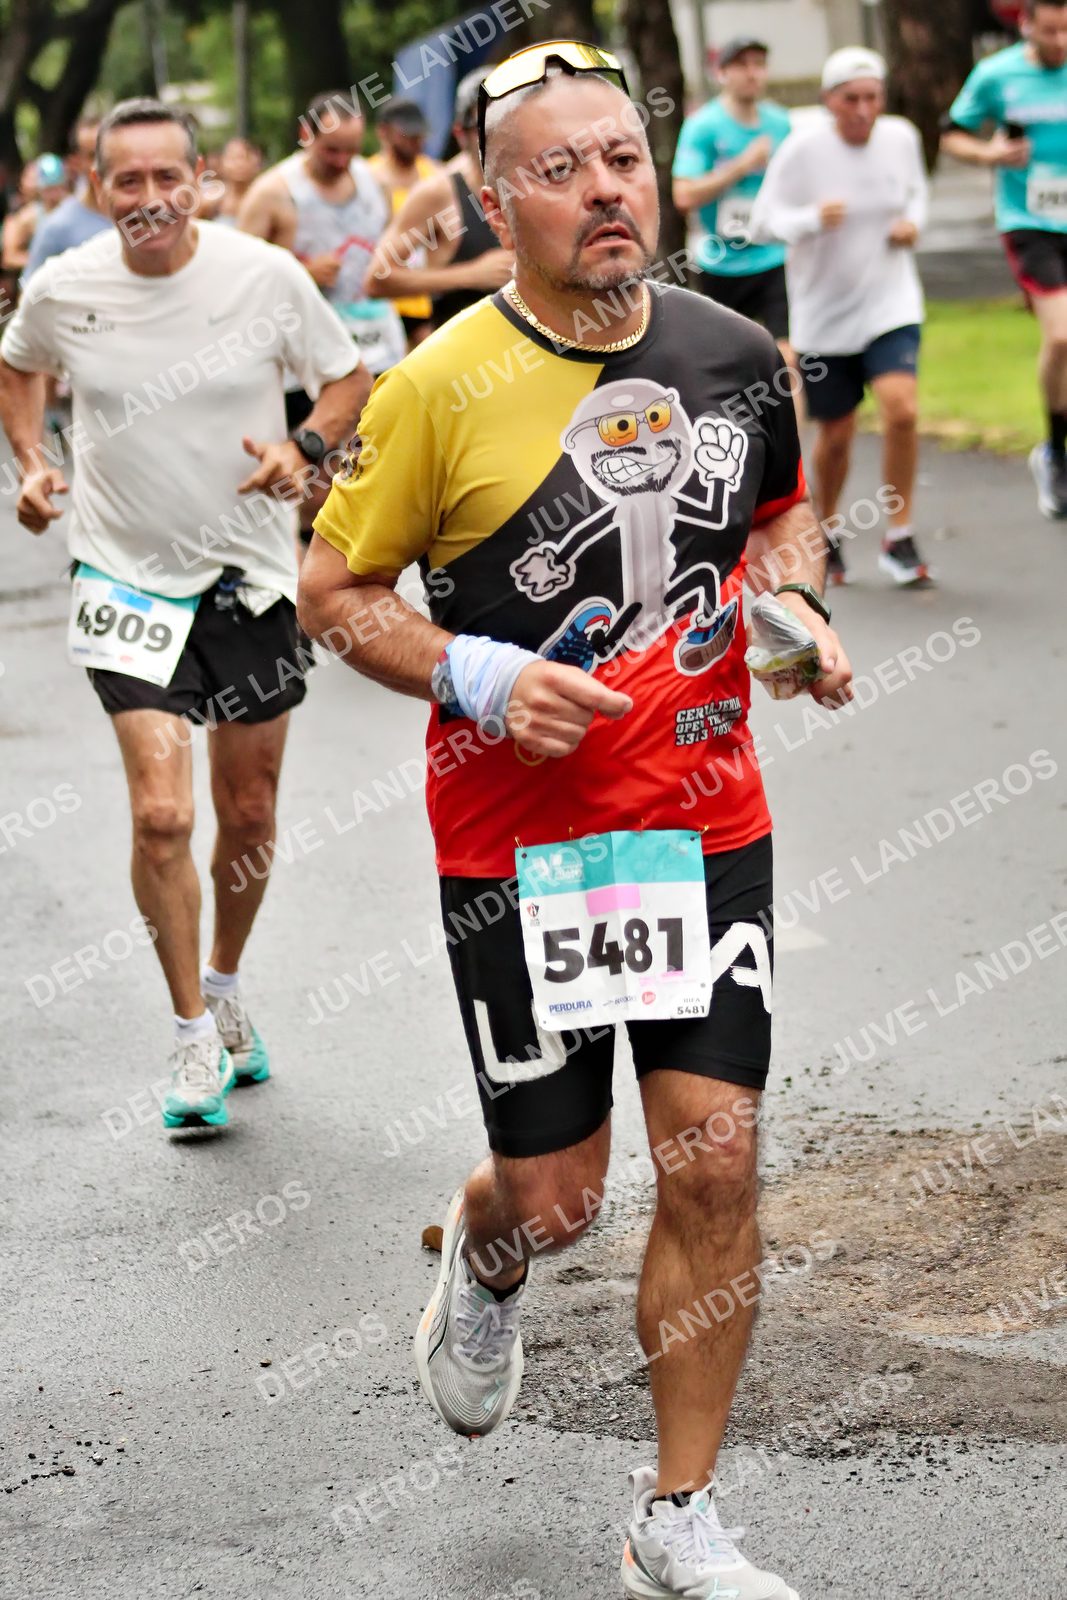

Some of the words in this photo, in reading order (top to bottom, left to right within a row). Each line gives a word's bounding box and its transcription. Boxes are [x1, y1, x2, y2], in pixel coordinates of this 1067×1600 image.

[77, 601, 173, 653] 4909
[543, 918, 683, 983] 5481
[549, 1000, 592, 1013] PERDURA
[677, 1005, 705, 1015] 5481
